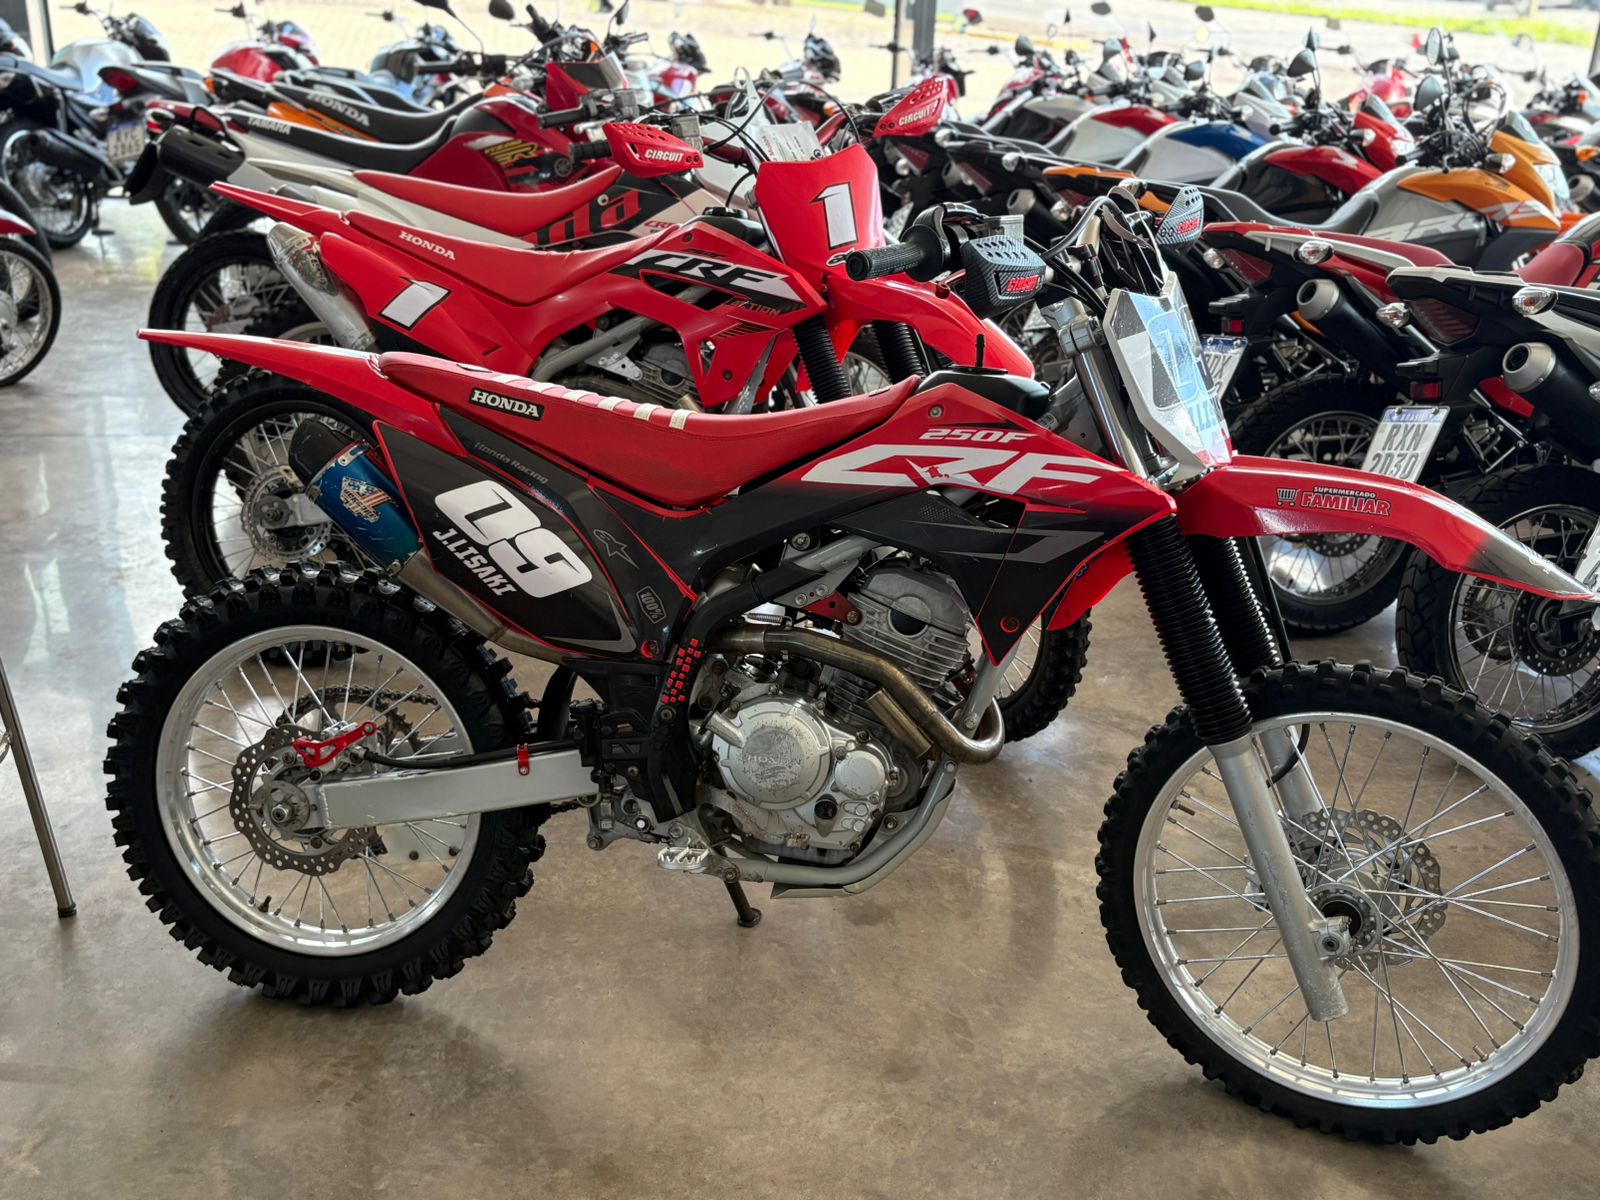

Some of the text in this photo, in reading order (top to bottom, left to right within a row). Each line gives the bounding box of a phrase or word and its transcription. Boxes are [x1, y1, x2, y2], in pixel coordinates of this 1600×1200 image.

[306, 93, 370, 127] HONDA
[899, 108, 931, 126] CIRCUIT
[247, 117, 291, 135] YAMAHA
[644, 149, 685, 163] CIRCUIT
[811, 182, 858, 249] 1
[399, 230, 456, 261] HONDA
[607, 250, 790, 287] CRF
[471, 389, 540, 418] HONDA
[918, 427, 1038, 443] 250F
[1382, 423, 1428, 452] RXN
[473, 441, 549, 485] Honda Racing
[800, 443, 1130, 495] CRF
[1301, 492, 1391, 516] FAMILIAR
[1313, 486, 1376, 499] SUPERMERCADO
[434, 479, 593, 598] 09
[639, 590, 664, 620] 100%
